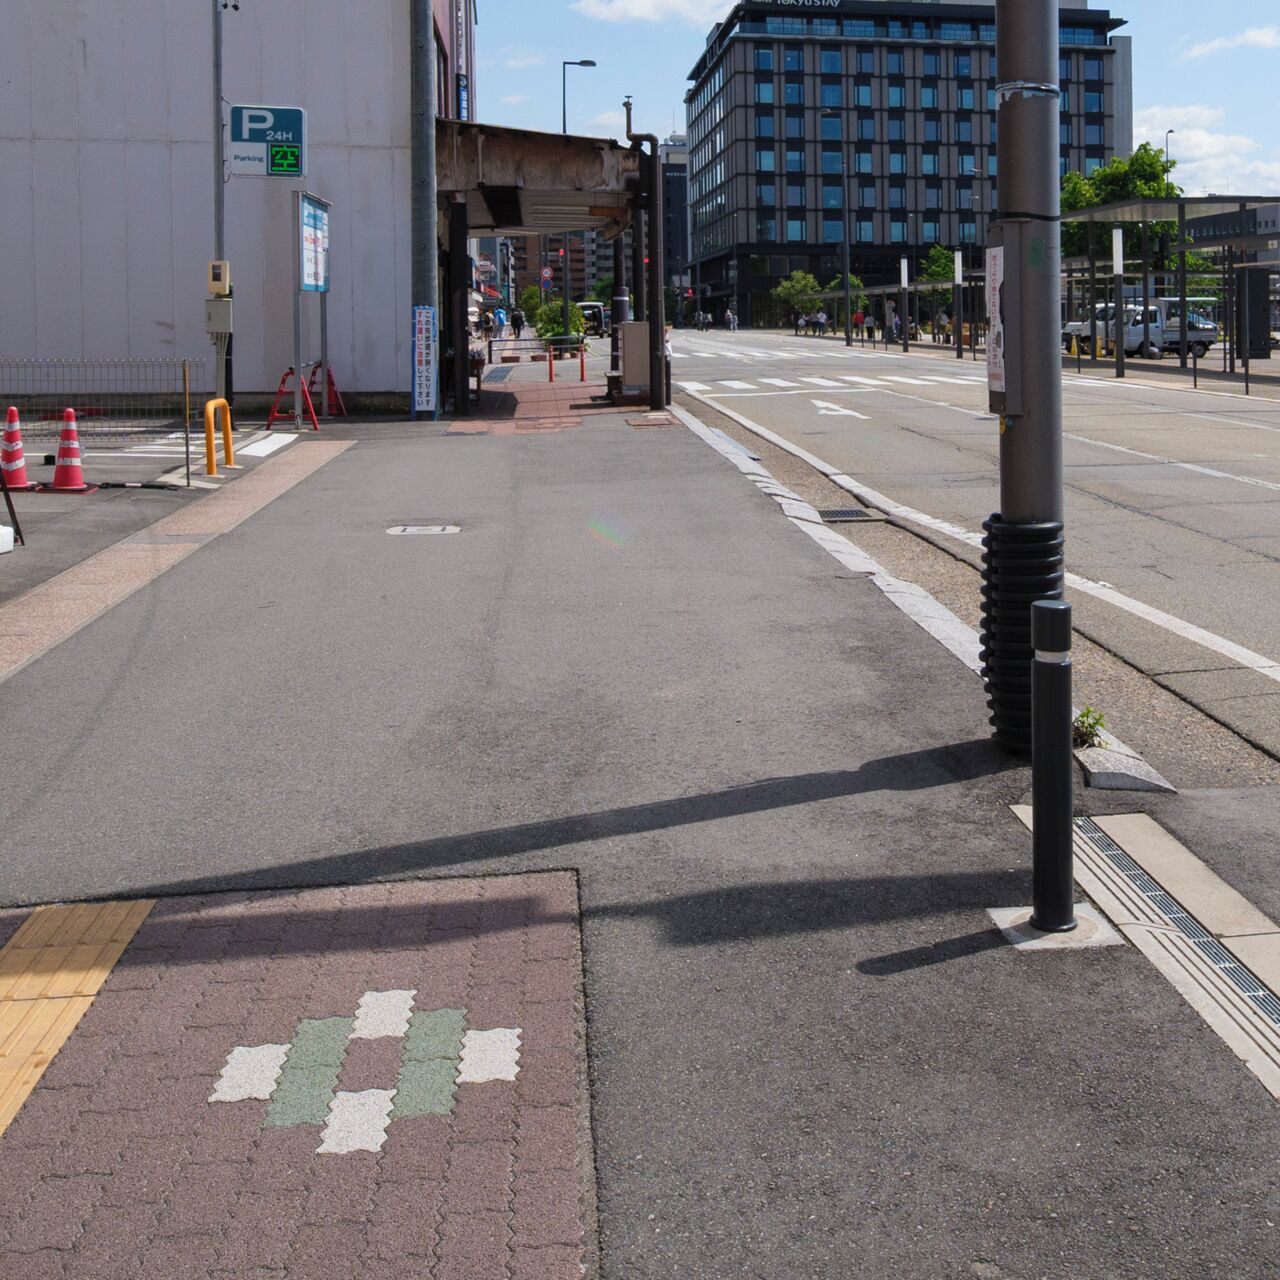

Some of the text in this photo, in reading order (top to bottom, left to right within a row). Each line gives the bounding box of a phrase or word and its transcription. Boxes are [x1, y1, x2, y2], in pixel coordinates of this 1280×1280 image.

[242, 109, 274, 139] P
[266, 131, 292, 141] 24H
[234, 154, 264, 163] Parking
[271, 145, 299, 171] 空
